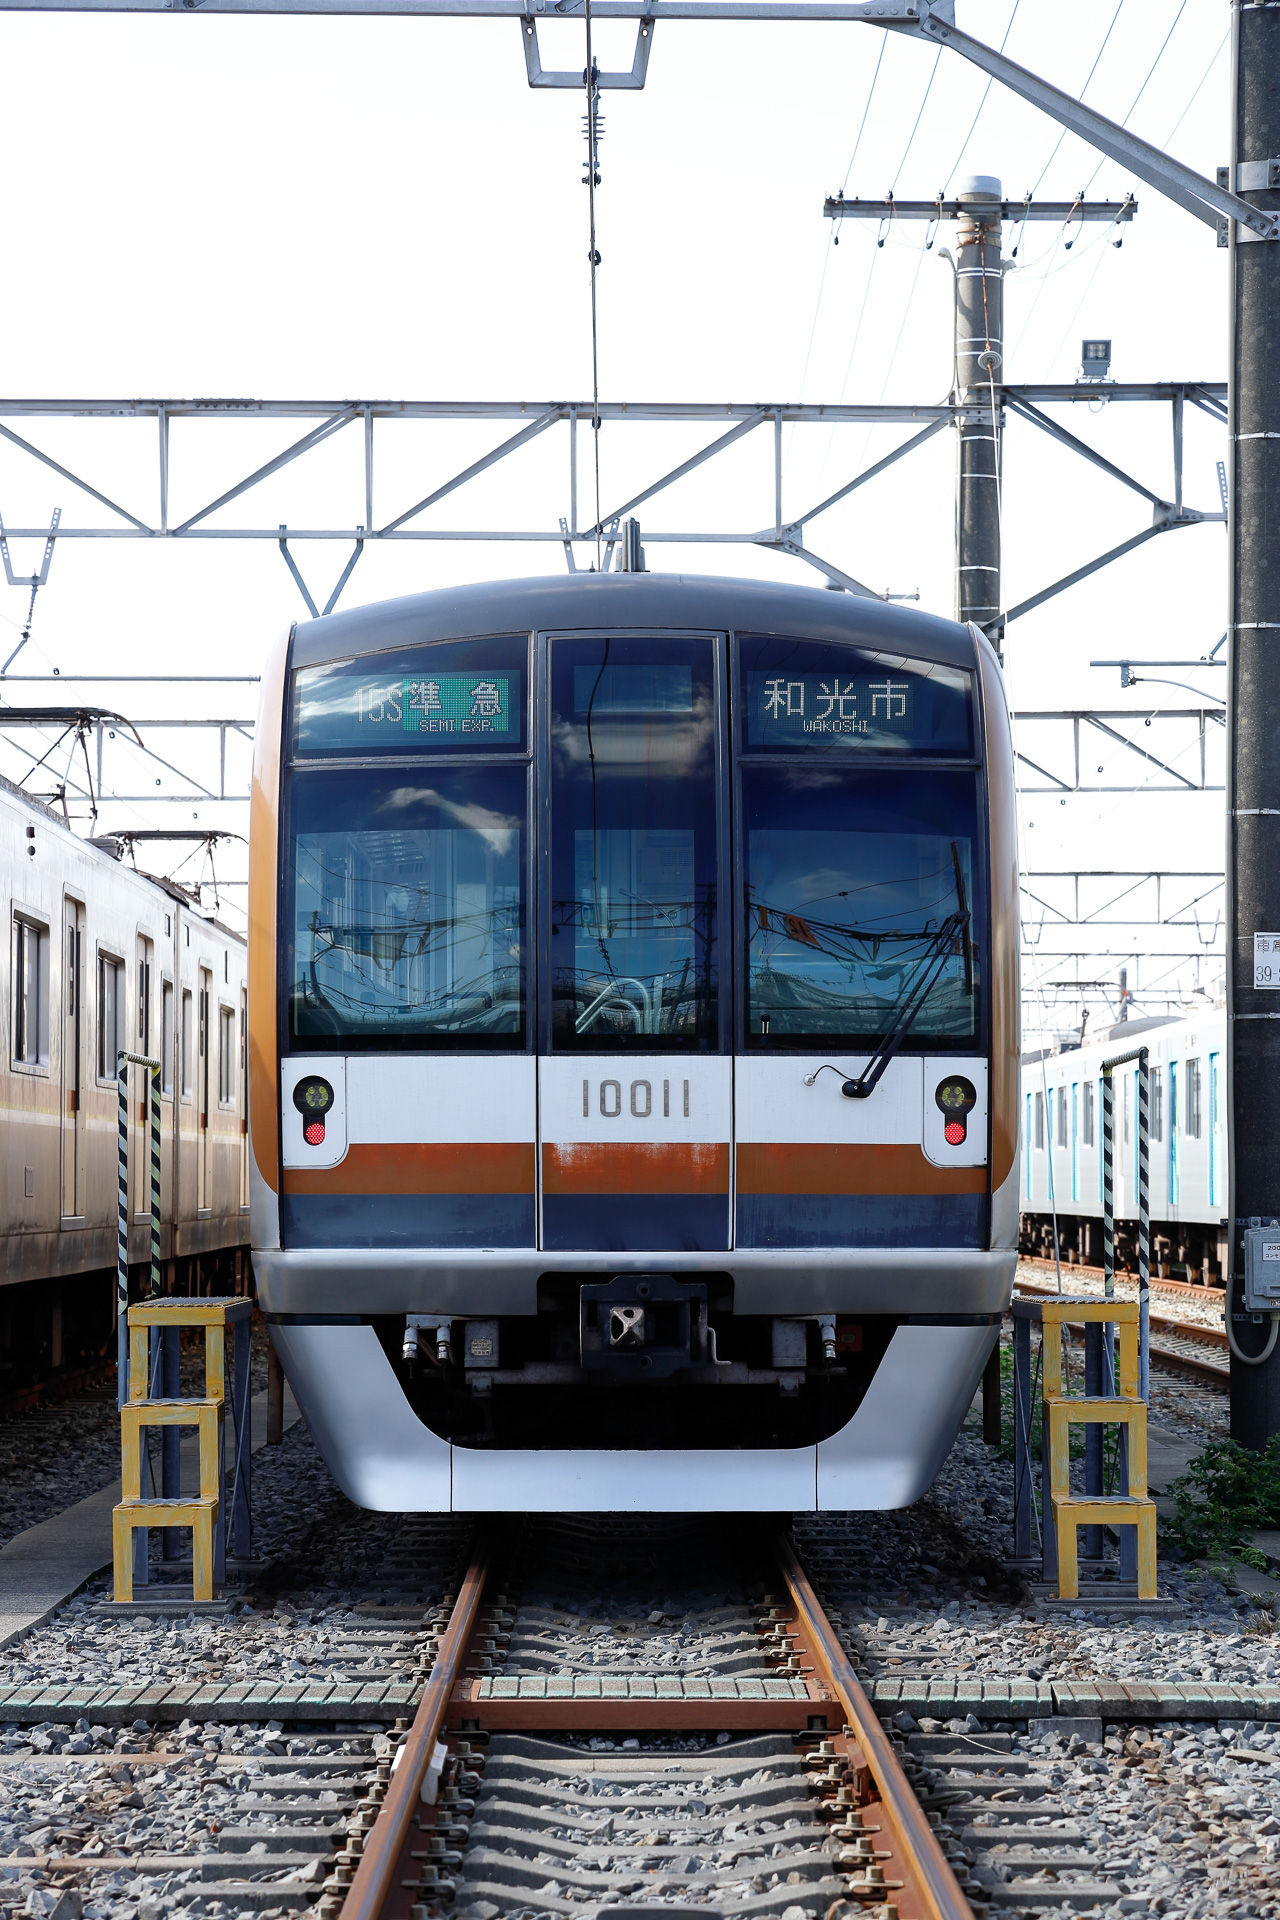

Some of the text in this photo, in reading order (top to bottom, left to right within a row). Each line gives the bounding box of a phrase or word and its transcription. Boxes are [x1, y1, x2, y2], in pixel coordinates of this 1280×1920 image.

[352, 688, 403, 722] 15S
[409, 681, 502, 716] 準急
[764, 679, 909, 719] 和光市
[419, 719, 494, 732] SEMI EXP.
[803, 720, 868, 733] WAKOSHI
[583, 1080, 689, 1117] 10011
